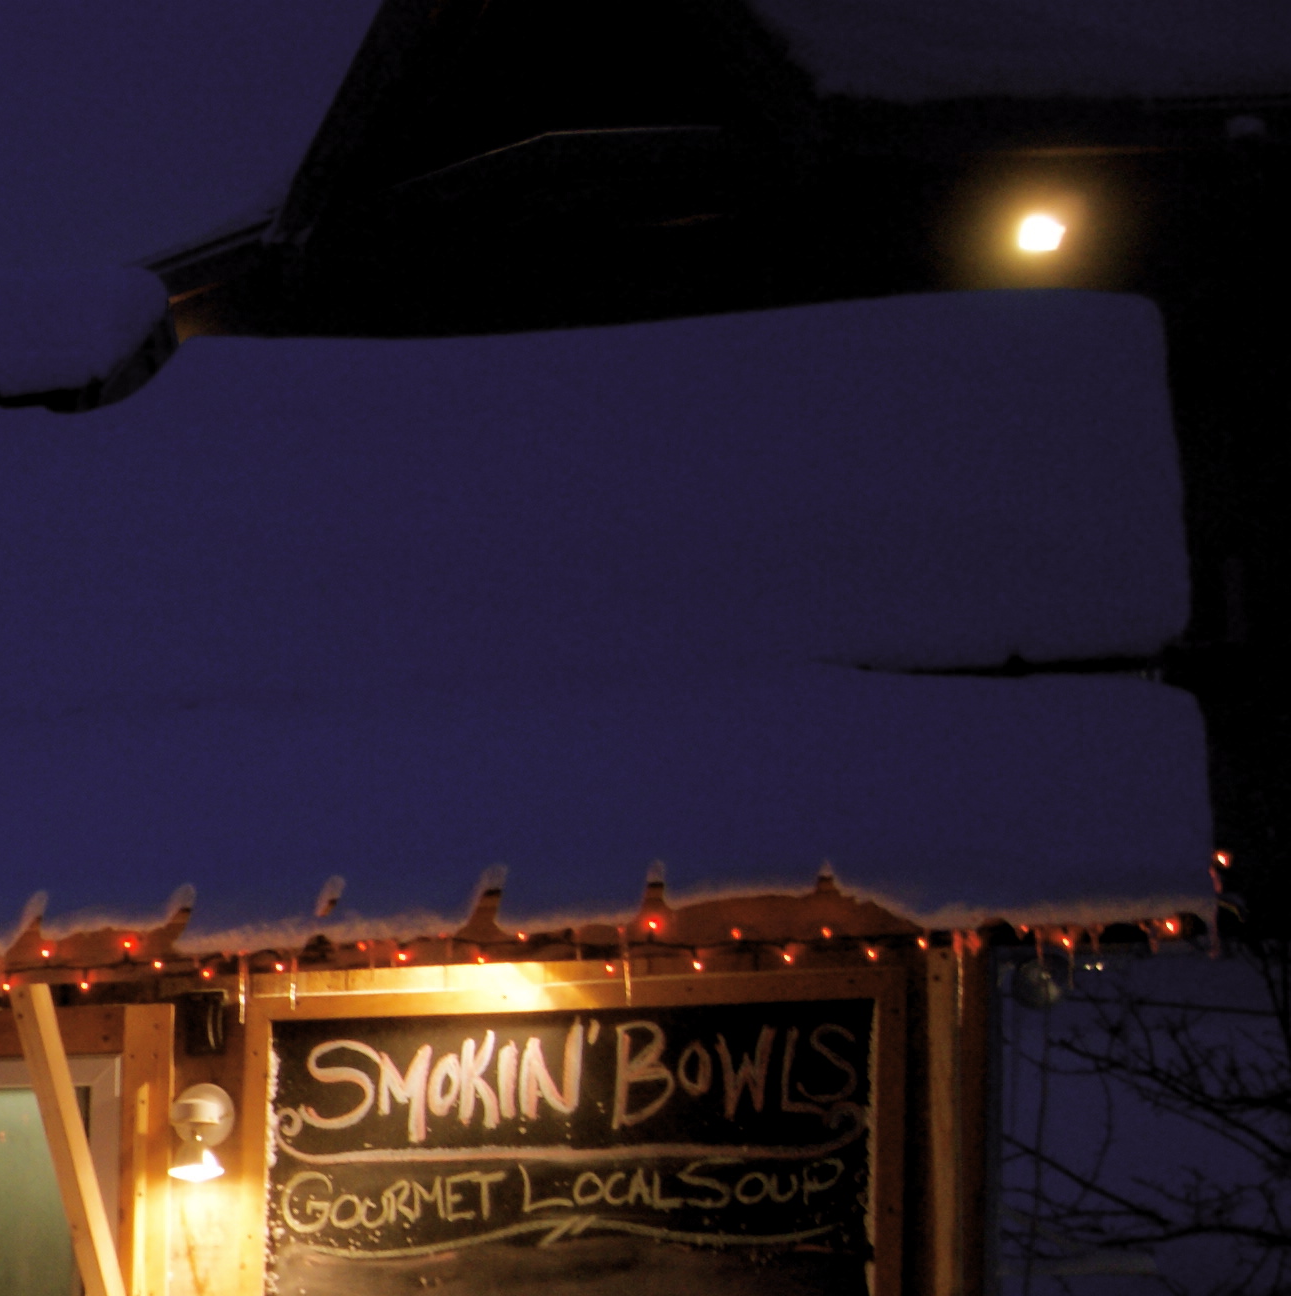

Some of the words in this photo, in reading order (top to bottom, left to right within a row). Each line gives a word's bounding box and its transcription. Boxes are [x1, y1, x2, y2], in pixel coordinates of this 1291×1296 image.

[307, 1014, 600, 1143] SMOKIN'
[612, 1020, 858, 1131] BOWLS
[281, 1170, 507, 1234] GOURMET
[518, 1163, 676, 1213] LOCAL
[676, 1157, 844, 1208] SOUP
